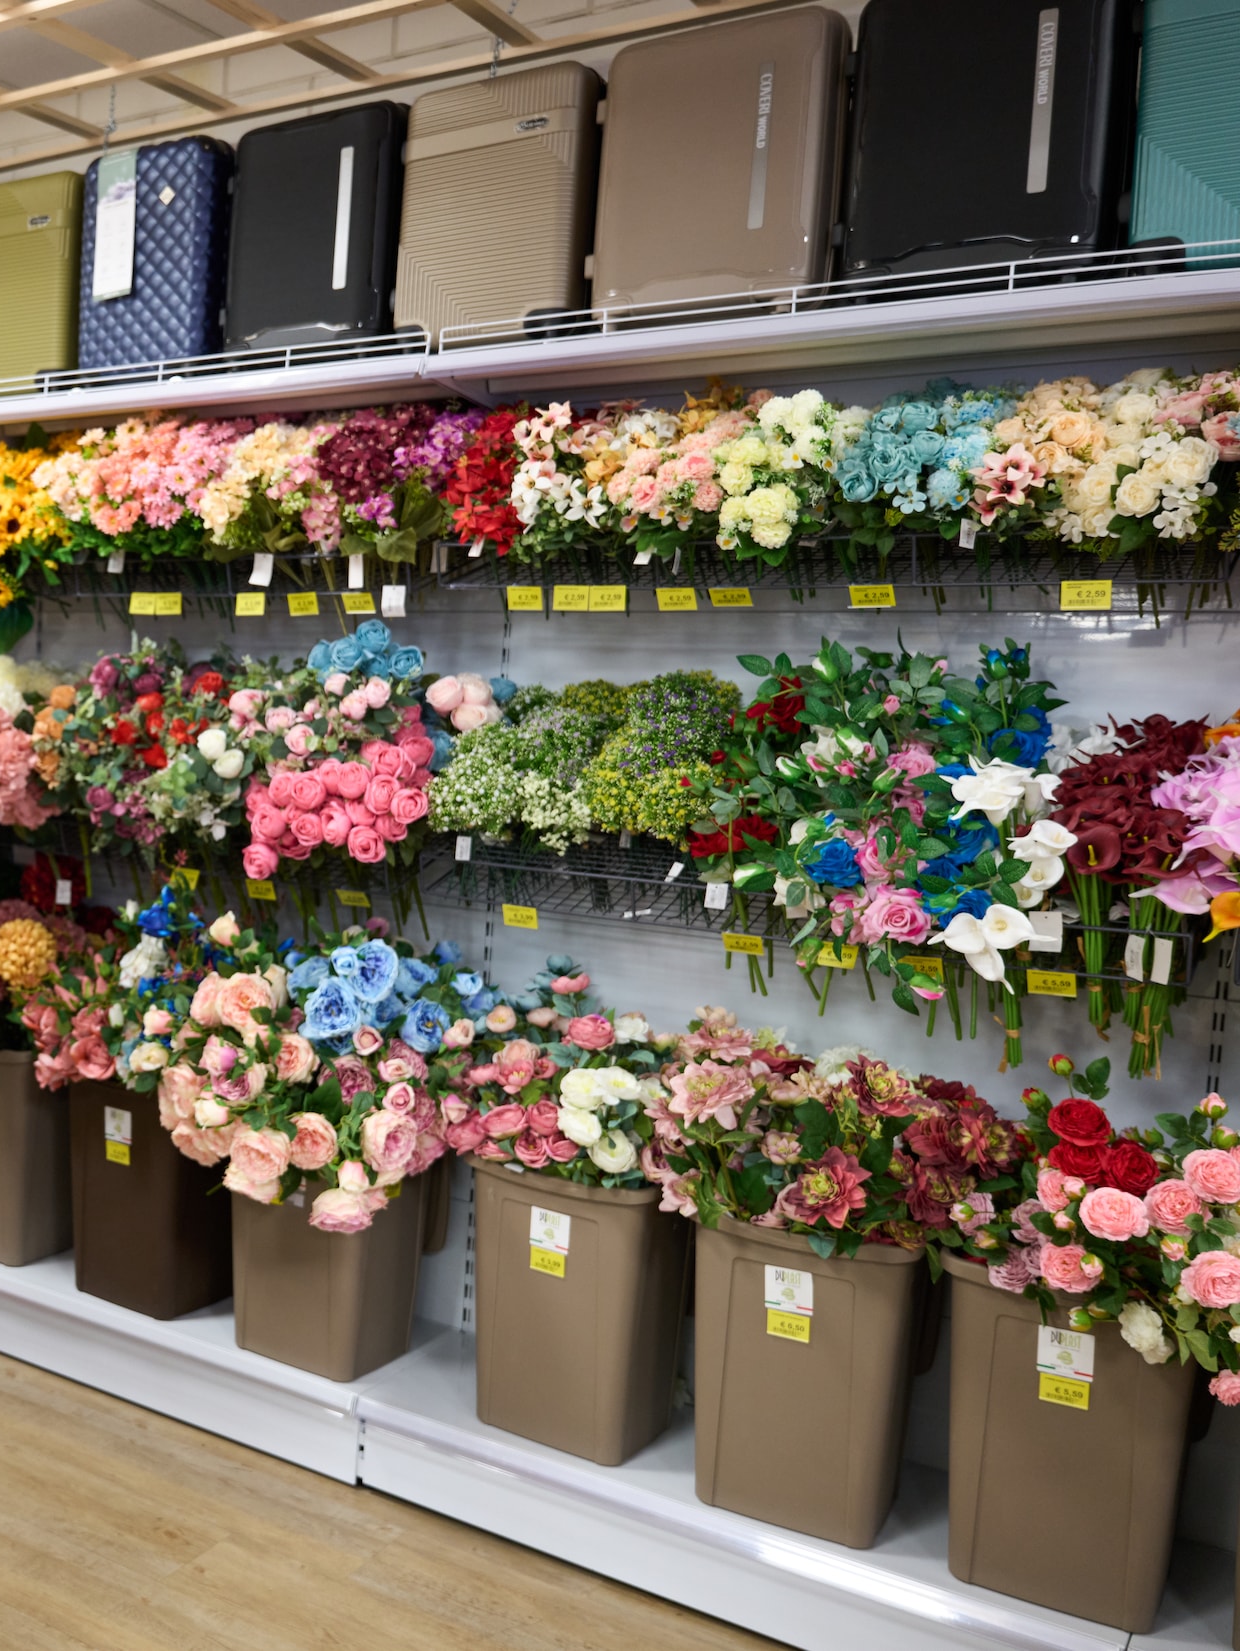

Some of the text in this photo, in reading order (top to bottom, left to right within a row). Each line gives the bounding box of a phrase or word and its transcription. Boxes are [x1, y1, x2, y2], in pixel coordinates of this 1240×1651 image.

[1037, 22, 1055, 105] COVERI WORLD
[756, 73, 773, 149] COVERI WORLD
[1077, 590, 1106, 599] € 2,59
